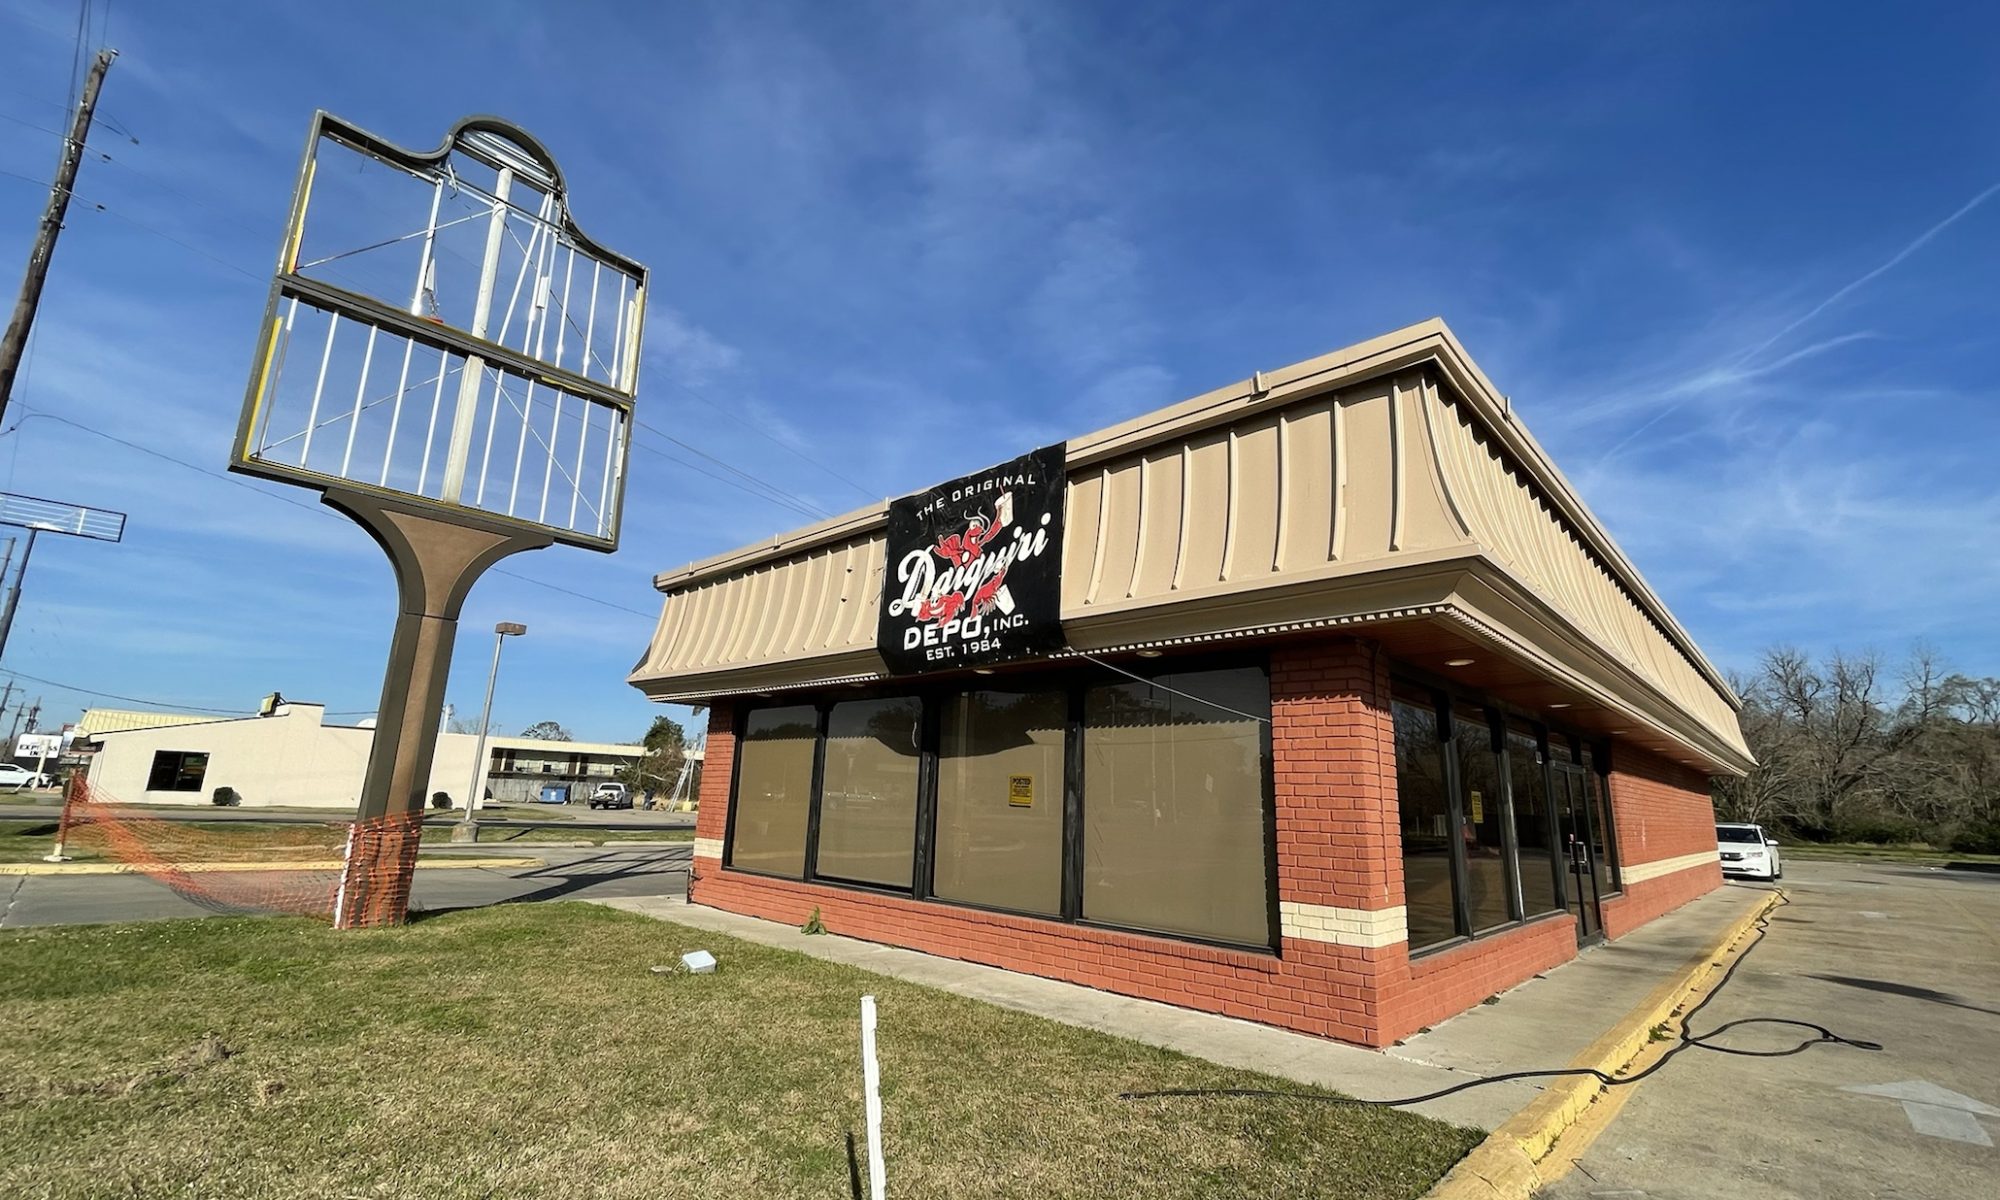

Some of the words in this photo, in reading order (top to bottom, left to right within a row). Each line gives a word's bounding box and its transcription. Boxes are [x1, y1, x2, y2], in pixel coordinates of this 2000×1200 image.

[916, 497, 945, 521] THE
[952, 473, 1036, 502] ORIGINAL
[888, 512, 1051, 617] Daiquiri
[993, 613, 1029, 631] INC.
[926, 646, 955, 661] EST.
[962, 638, 1001, 655] 1984
